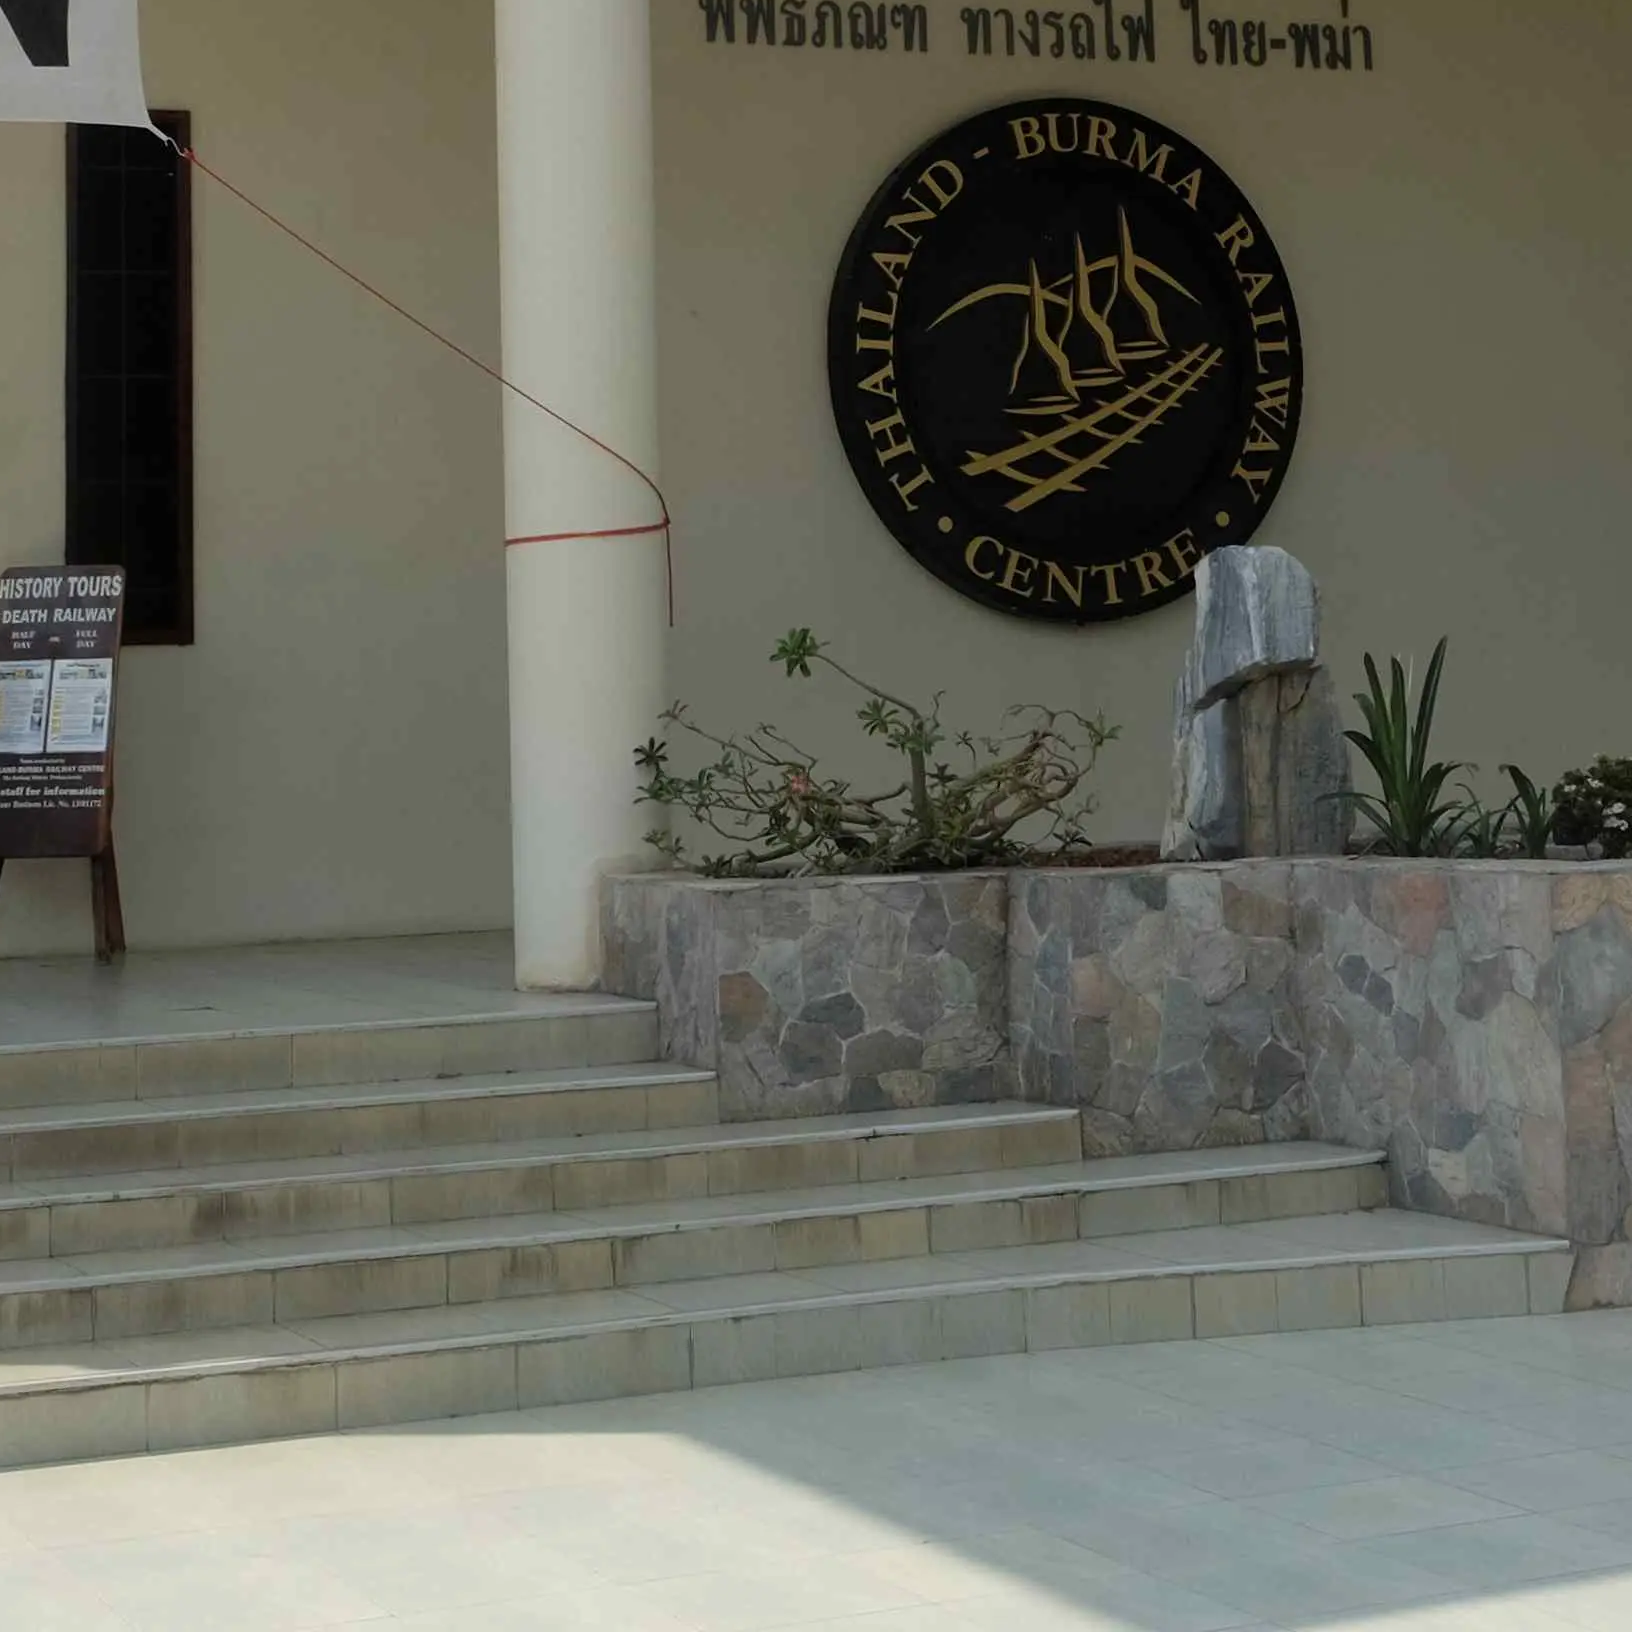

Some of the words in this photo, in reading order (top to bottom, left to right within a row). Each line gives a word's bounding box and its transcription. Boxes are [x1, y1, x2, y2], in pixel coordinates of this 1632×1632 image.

[855, 158, 965, 512] THAILAND
[1008, 113, 1203, 210] BURMA
[1214, 213, 1293, 503] RAILWAY
[964, 528, 1207, 607] CENTRE
[0, 577, 63, 599] HISTORY
[68, 575, 122, 597] TOURS
[2, 609, 48, 624] DEATH
[53, 607, 116, 623] RAILWAY
[44, 785, 106, 796] information
